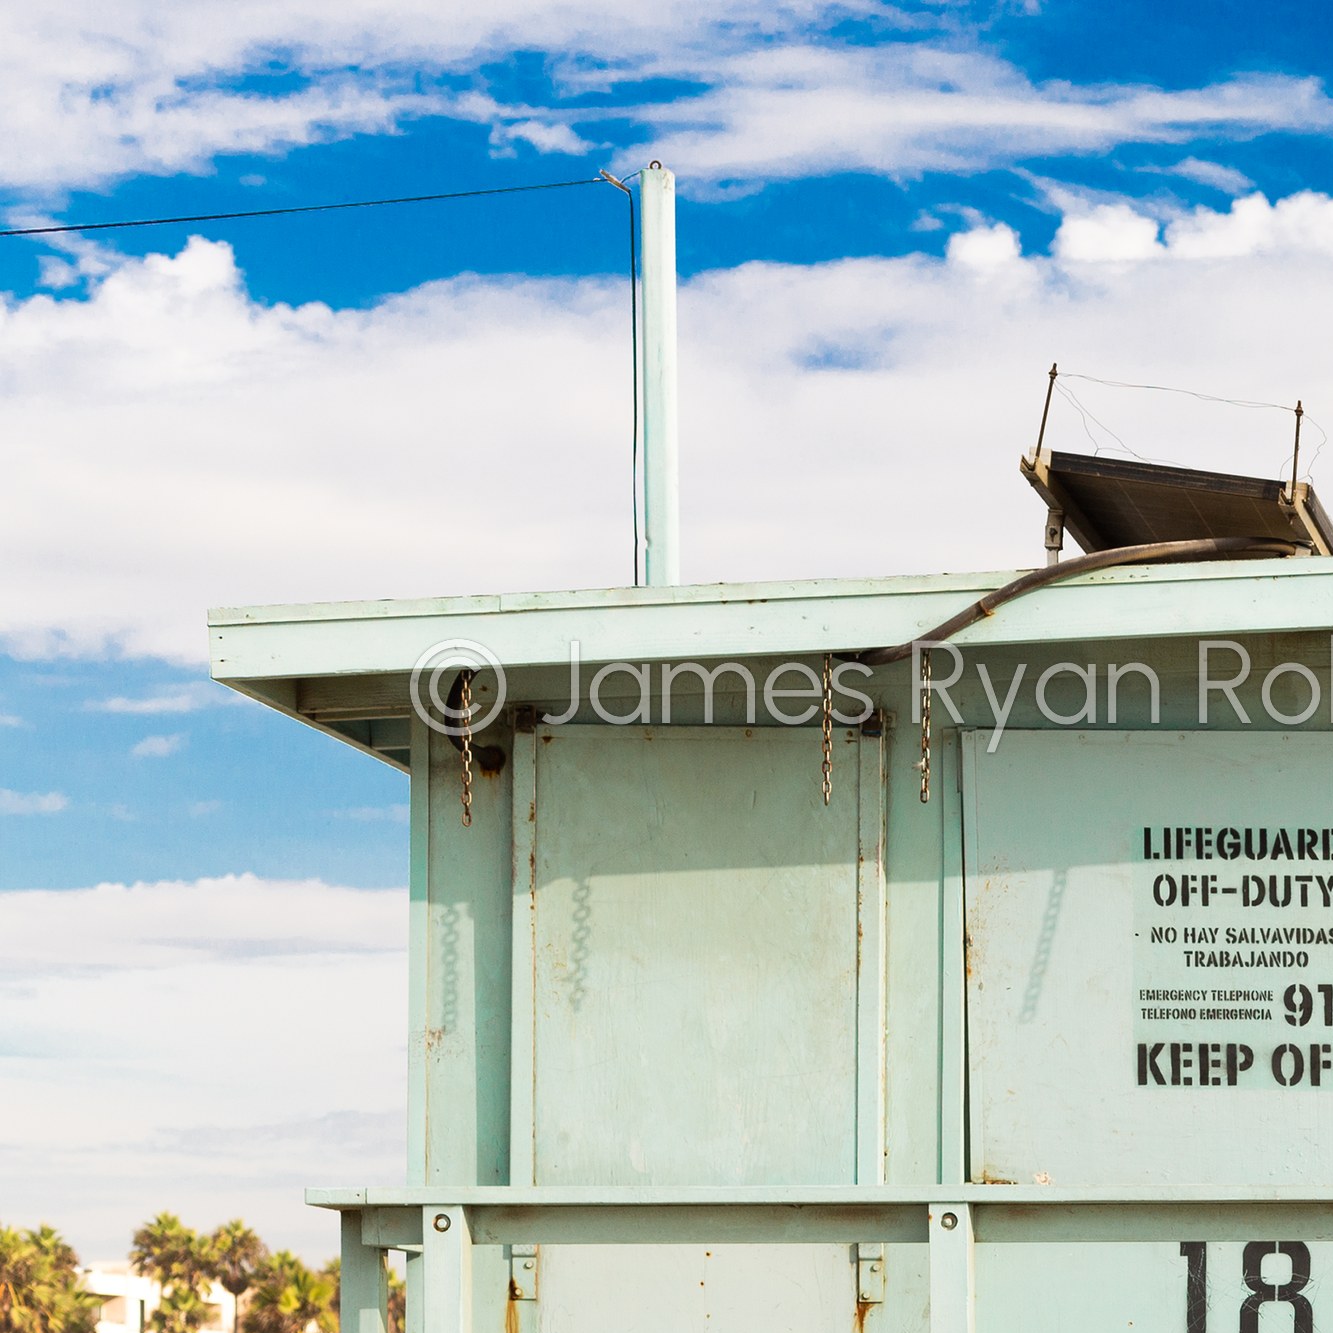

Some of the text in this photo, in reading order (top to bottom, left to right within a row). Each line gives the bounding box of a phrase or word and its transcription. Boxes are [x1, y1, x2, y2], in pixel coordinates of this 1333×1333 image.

[1150, 926, 1177, 944] NO
[1183, 927, 1219, 944] HAY
[1183, 950, 1309, 968] TRABAJANDO
[1139, 989, 1274, 1002] EMERGENCY TELEPHONE
[1141, 1008, 1272, 1020] TELEFONO EMERGENCIA
[1137, 1042, 1254, 1086] KEEP
